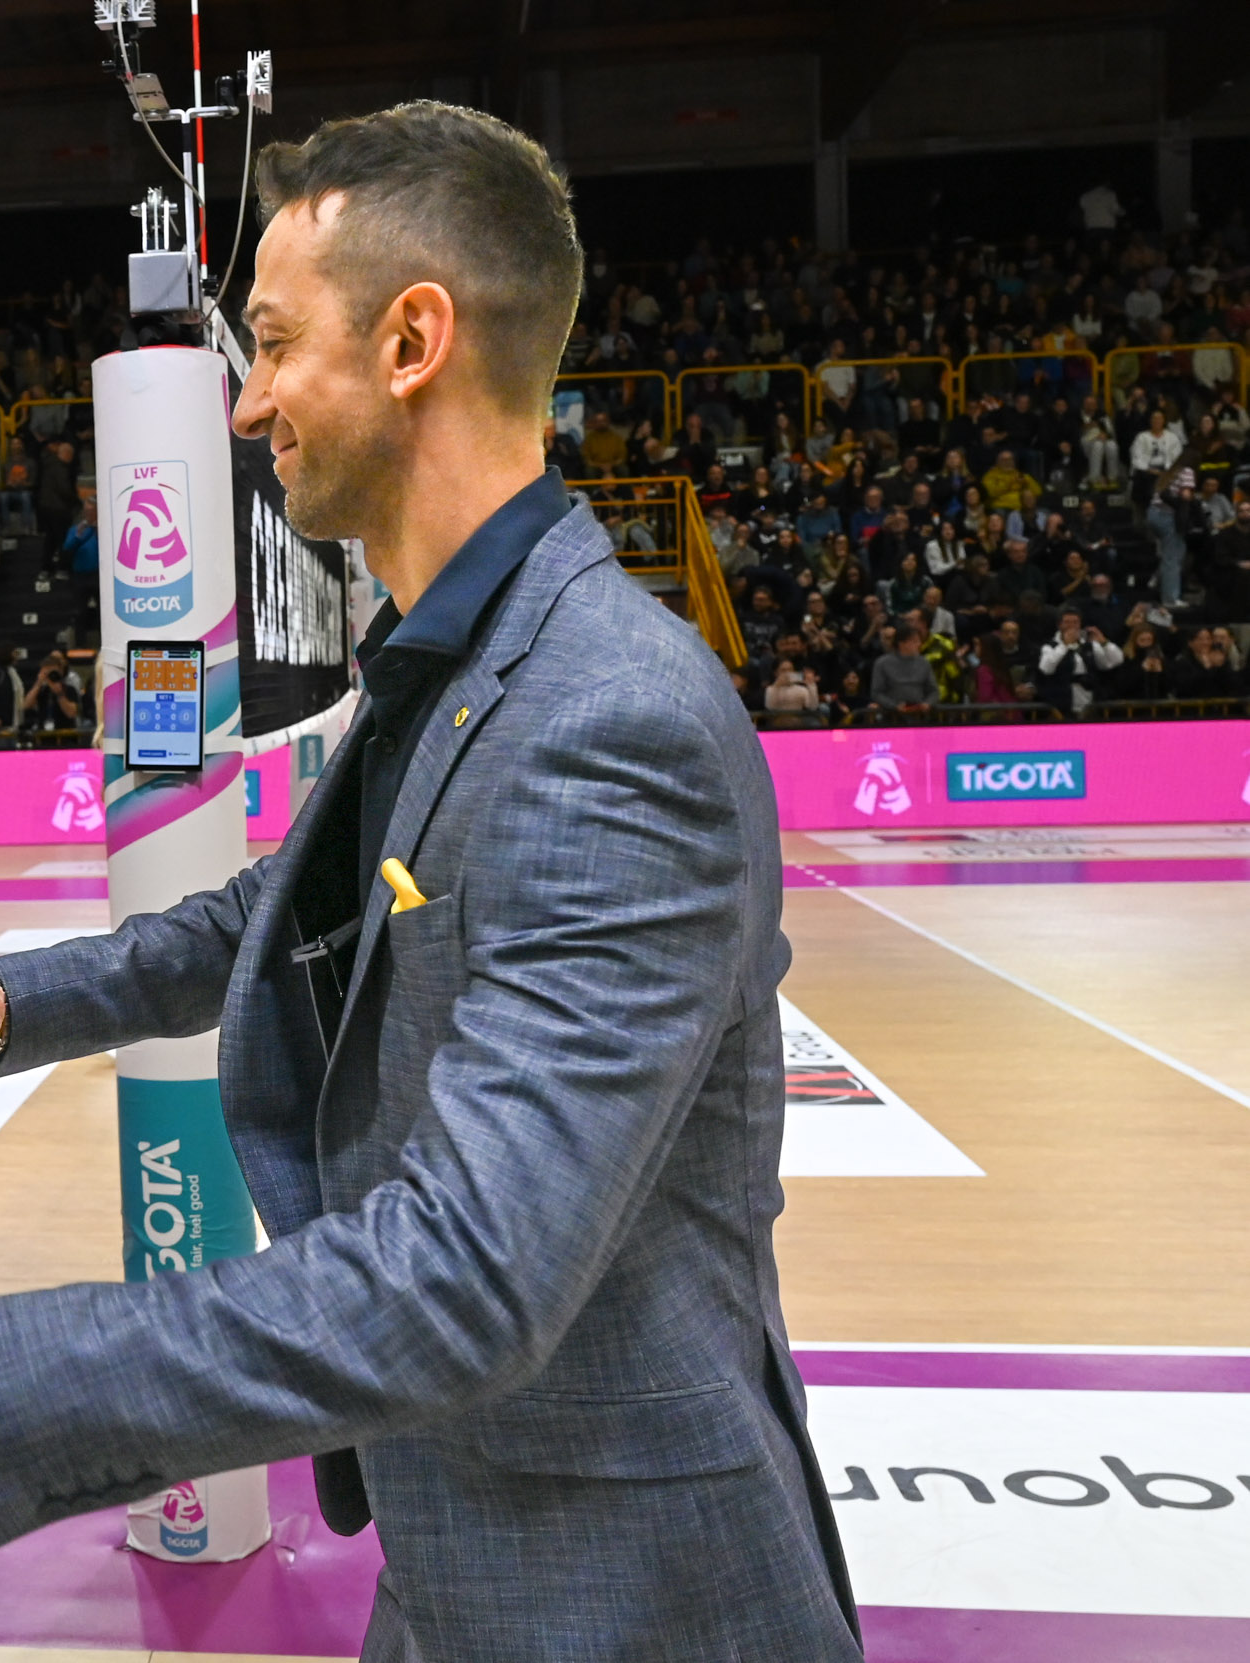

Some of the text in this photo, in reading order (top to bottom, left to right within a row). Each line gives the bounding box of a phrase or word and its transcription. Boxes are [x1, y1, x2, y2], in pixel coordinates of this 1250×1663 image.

[134, 466, 158, 480] LVF
[134, 574, 166, 584] SERIE A
[186, 1174, 204, 1268] fair, feel good
